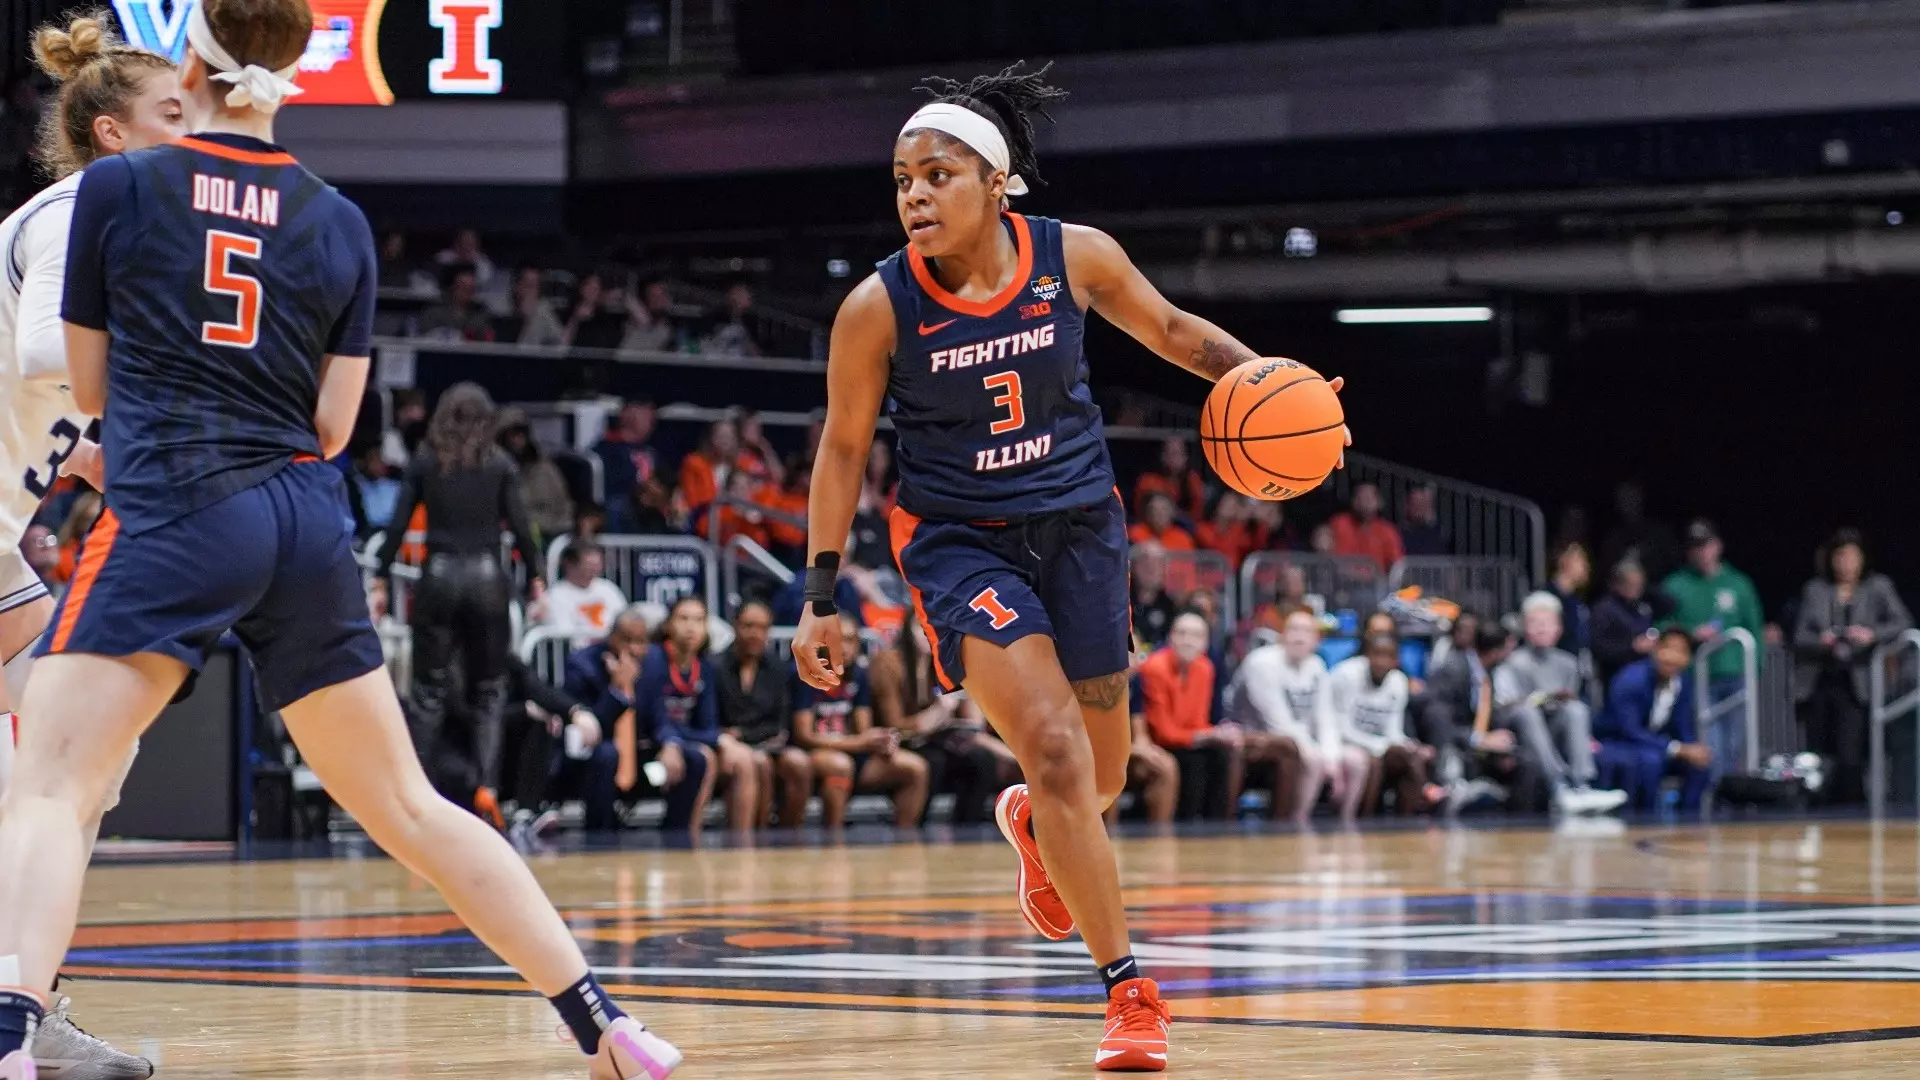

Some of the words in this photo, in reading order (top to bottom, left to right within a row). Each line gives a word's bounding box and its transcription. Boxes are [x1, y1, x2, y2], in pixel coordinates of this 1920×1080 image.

[429, 0, 502, 93] I
[193, 173, 279, 227] DOLAN
[202, 229, 263, 349] 5
[1032, 282, 1061, 294] WBIT
[930, 323, 1055, 373] FIGHTING
[983, 370, 1025, 435] 3
[975, 434, 1051, 471] ILLINI
[968, 587, 1020, 630] I
